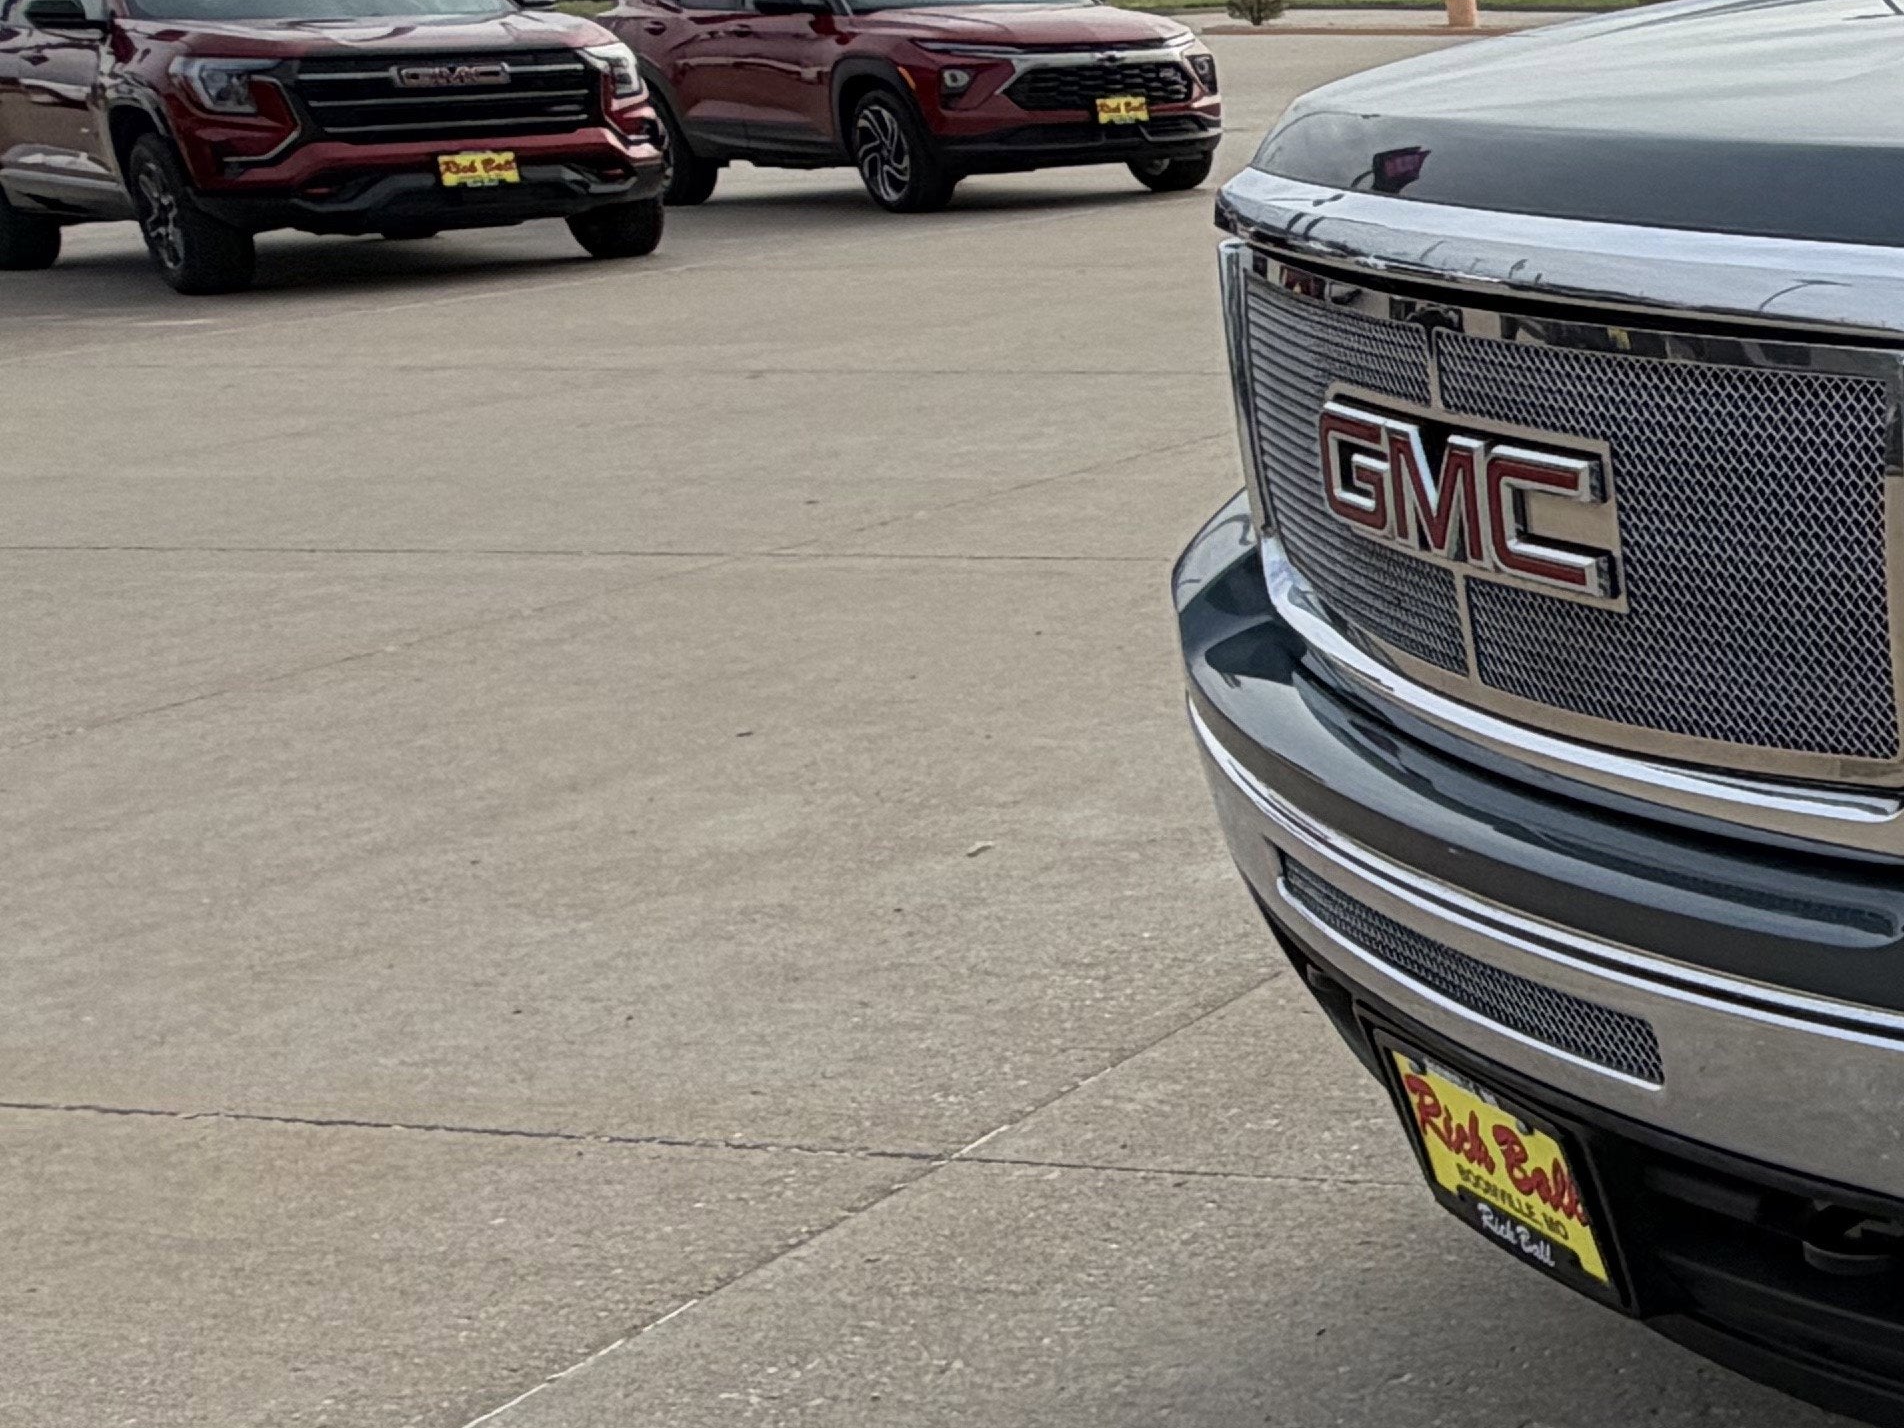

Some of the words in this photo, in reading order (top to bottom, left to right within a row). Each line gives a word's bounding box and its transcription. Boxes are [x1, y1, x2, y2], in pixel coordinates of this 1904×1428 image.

[1319, 401, 1621, 600] GMC
[1404, 1073, 1496, 1176] Rick
[1492, 1123, 1591, 1227] Ball
